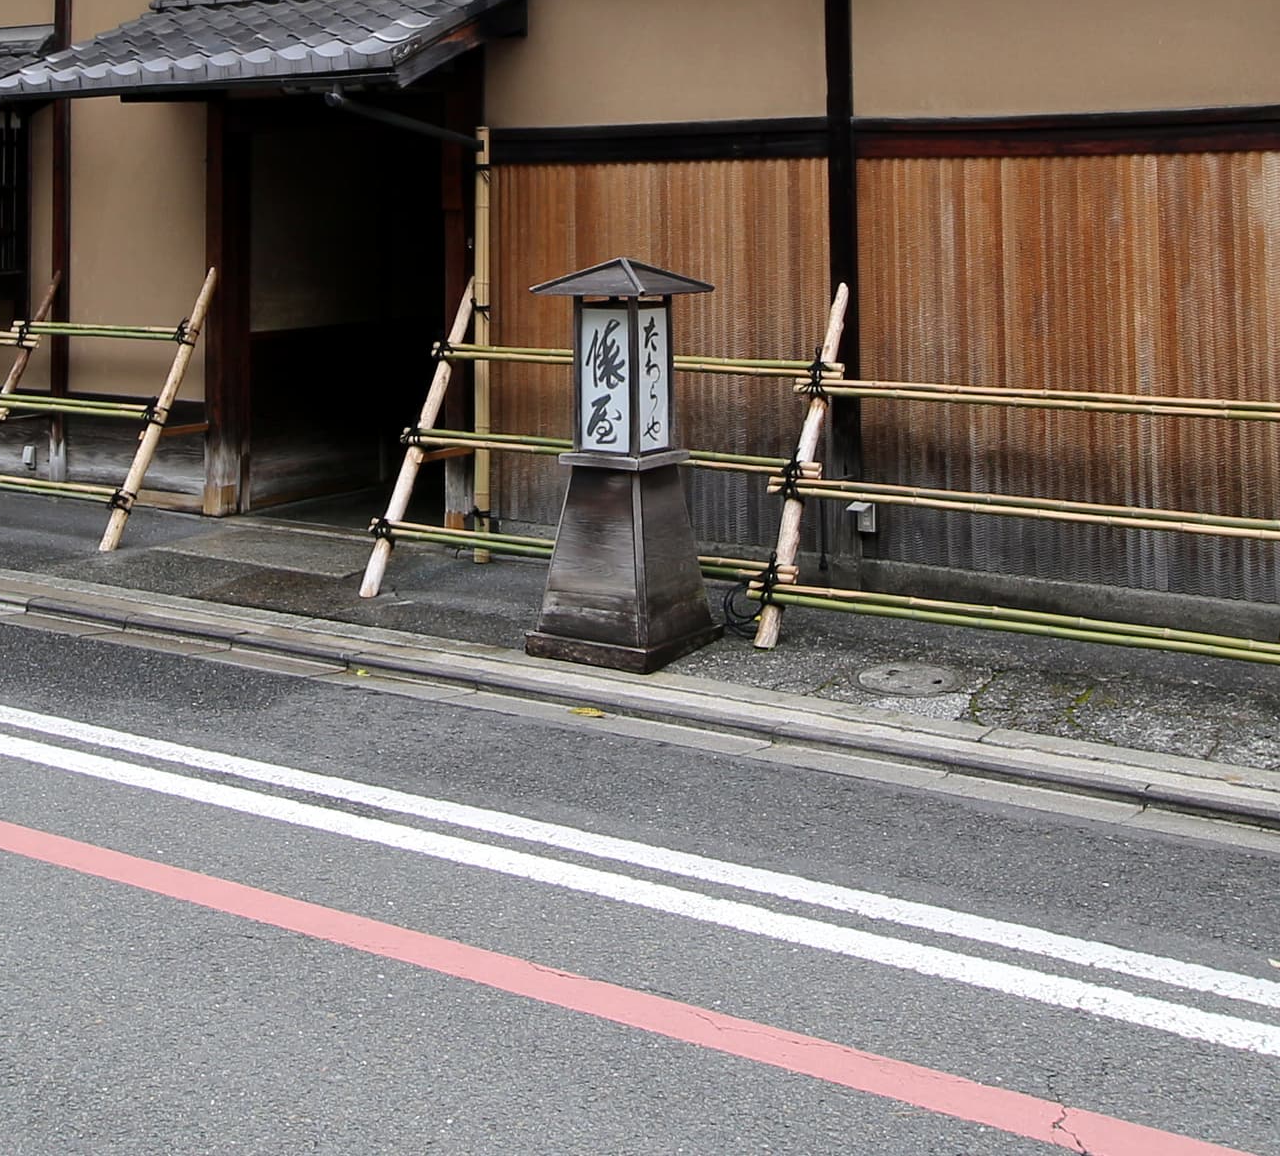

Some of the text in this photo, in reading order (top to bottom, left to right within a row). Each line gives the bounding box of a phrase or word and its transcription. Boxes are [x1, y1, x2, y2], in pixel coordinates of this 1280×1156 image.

[585, 319, 625, 444] 俵屋
[643, 316, 661, 441] たわらや
